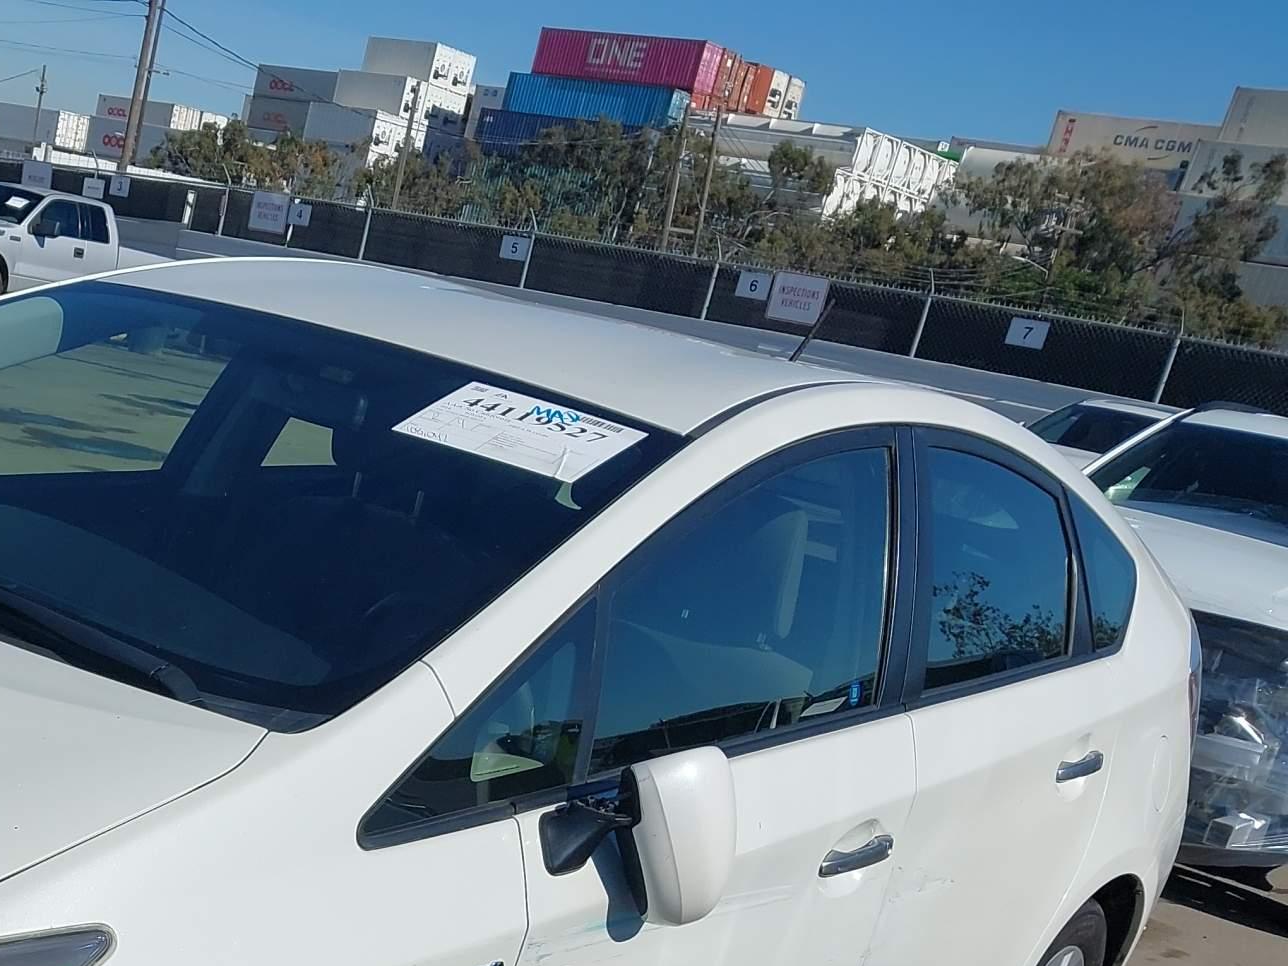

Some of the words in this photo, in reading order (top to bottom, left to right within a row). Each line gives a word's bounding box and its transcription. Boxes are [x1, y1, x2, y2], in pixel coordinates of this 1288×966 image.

[587, 38, 647, 68] ONE
[269, 79, 295, 92] OOCL
[108, 107, 127, 117] OOCL
[103, 134, 124, 148] OOC
[1113, 134, 1149, 149] CMA
[1154, 139, 1193, 153] CGM
[296, 209, 303, 219] 4
[511, 242, 519, 254] 5
[749, 280, 759, 292] 6
[778, 285, 820, 301] INSPECTIONS
[780, 299, 812, 311] VEHICLES
[1023, 326, 1034, 340] 7
[463, 398, 609, 443] 44119527
